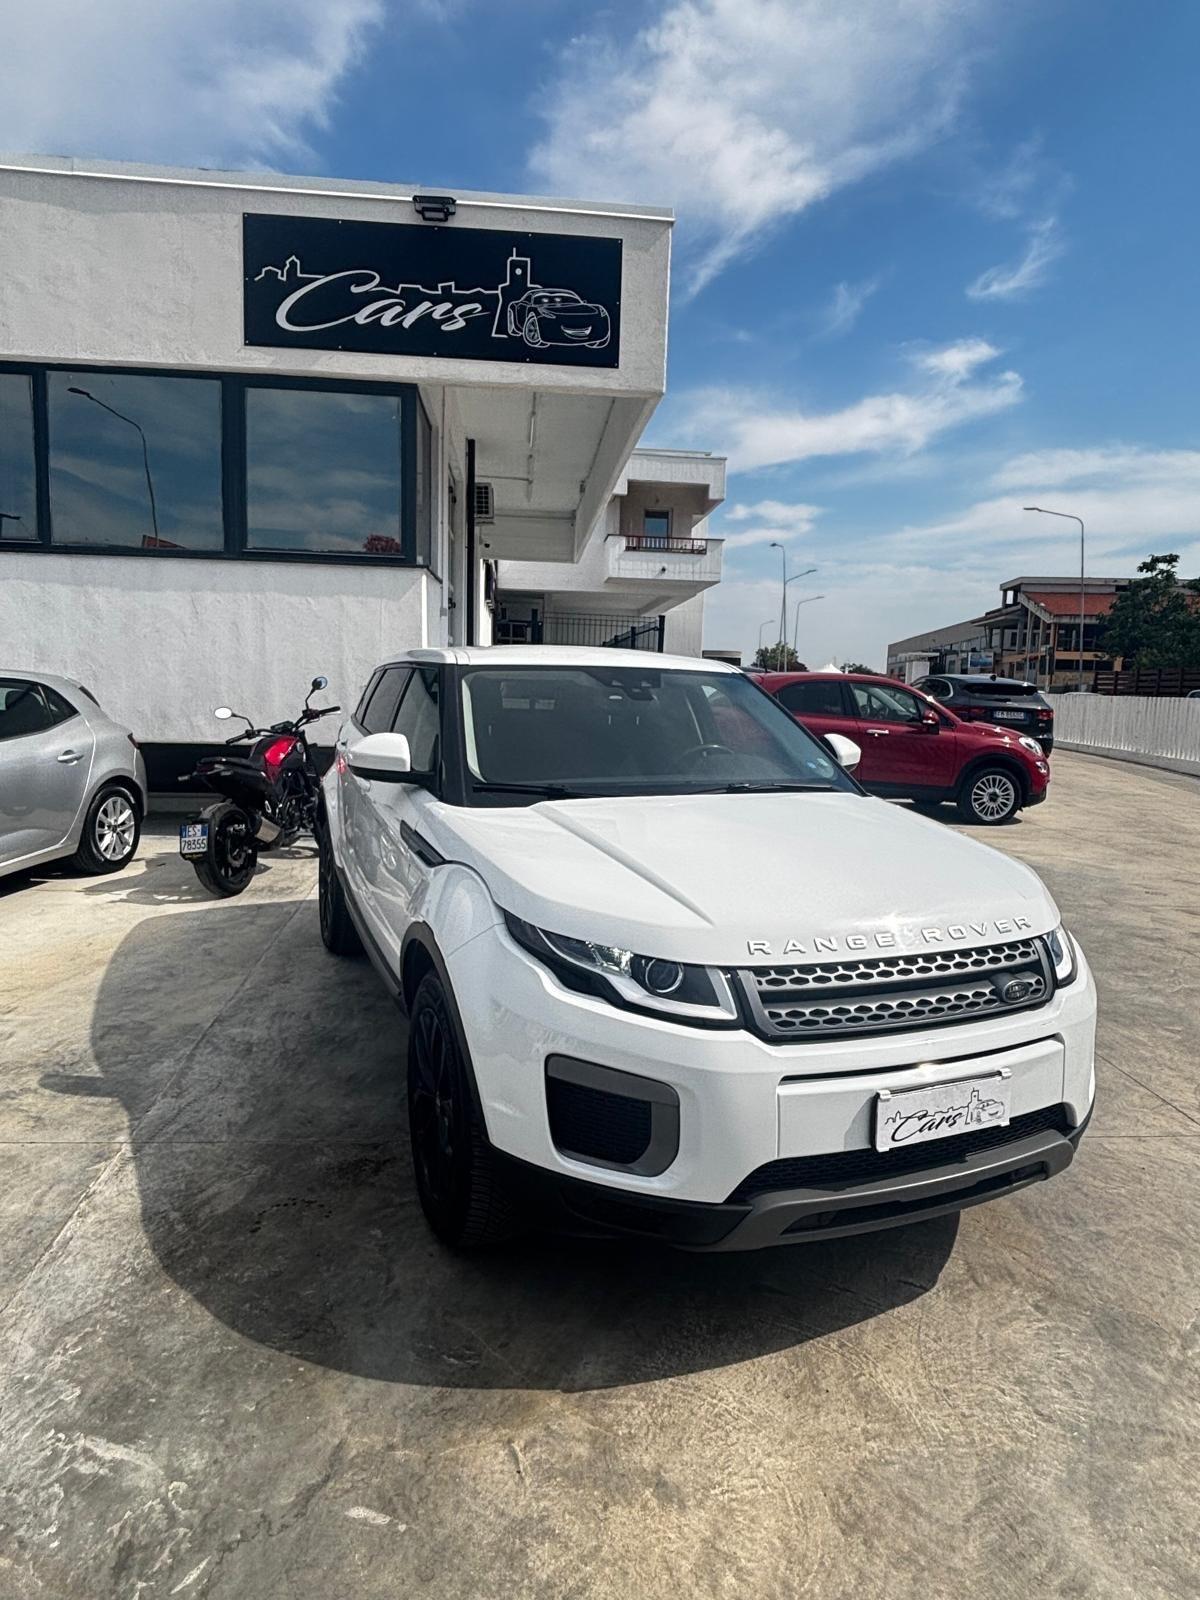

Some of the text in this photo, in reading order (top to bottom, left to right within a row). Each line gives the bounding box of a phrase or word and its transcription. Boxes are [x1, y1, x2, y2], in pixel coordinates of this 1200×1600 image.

[275, 269, 490, 331] Cars
[182, 839, 206, 851] 78355
[747, 915, 1033, 956] RANGE ROVER
[891, 1109, 966, 1142] Cars
